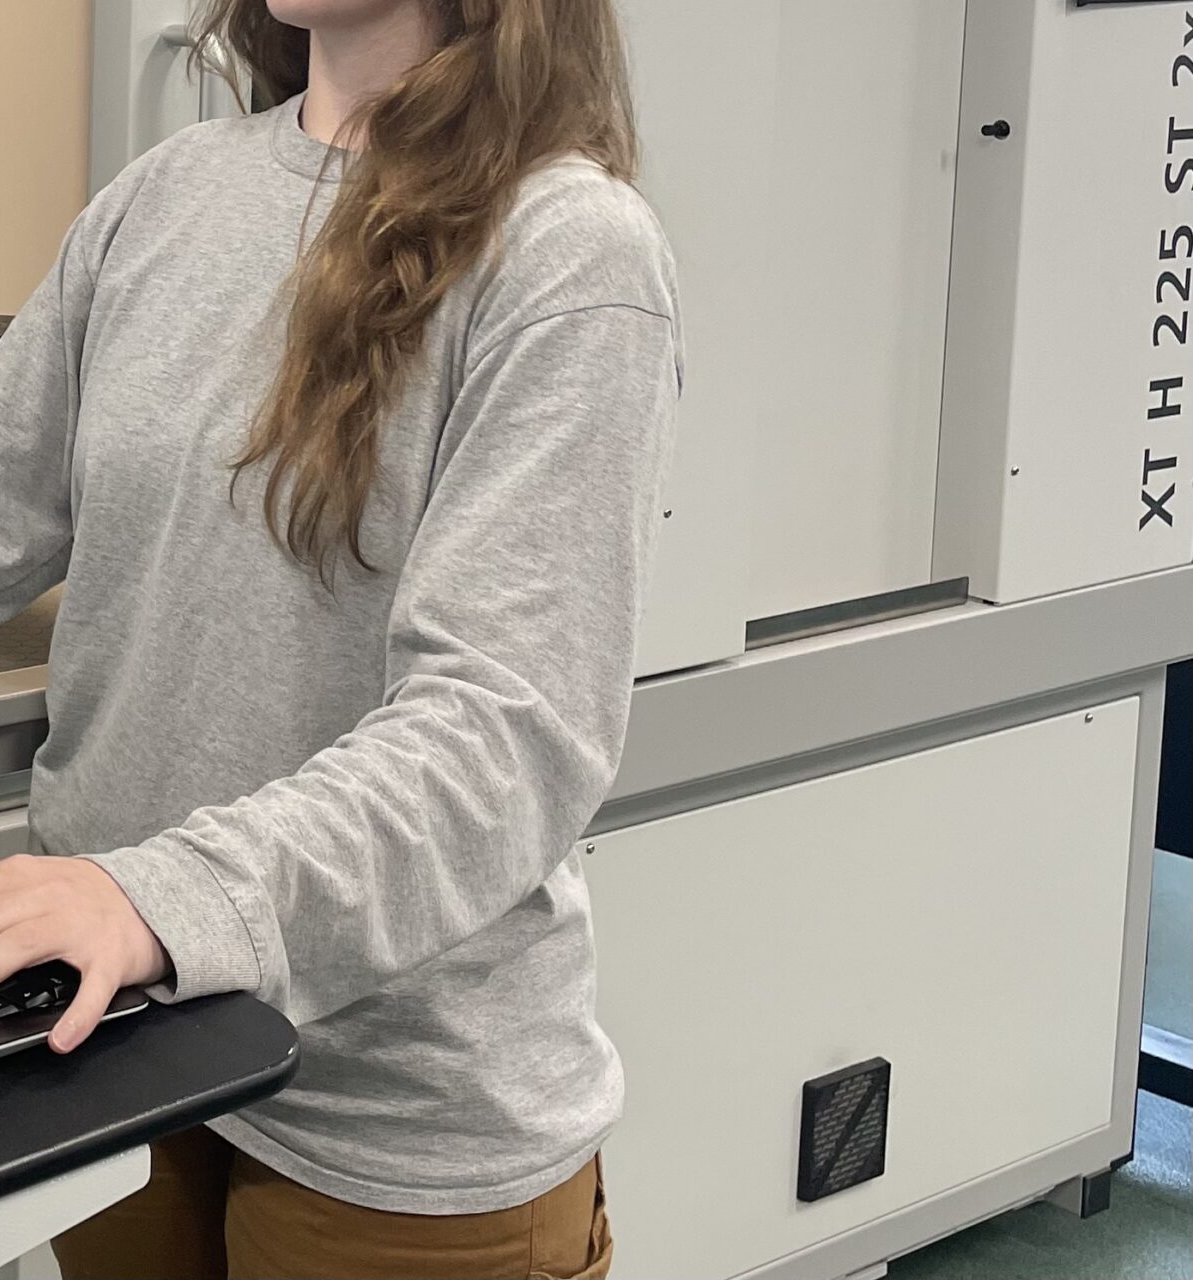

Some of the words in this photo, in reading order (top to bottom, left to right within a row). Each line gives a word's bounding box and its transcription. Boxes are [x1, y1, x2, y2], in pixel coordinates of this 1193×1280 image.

[1165, 116, 1193, 193] ST
[1153, 225, 1193, 347] 225
[1147, 376, 1183, 420] H
[1139, 449, 1178, 531] XT
